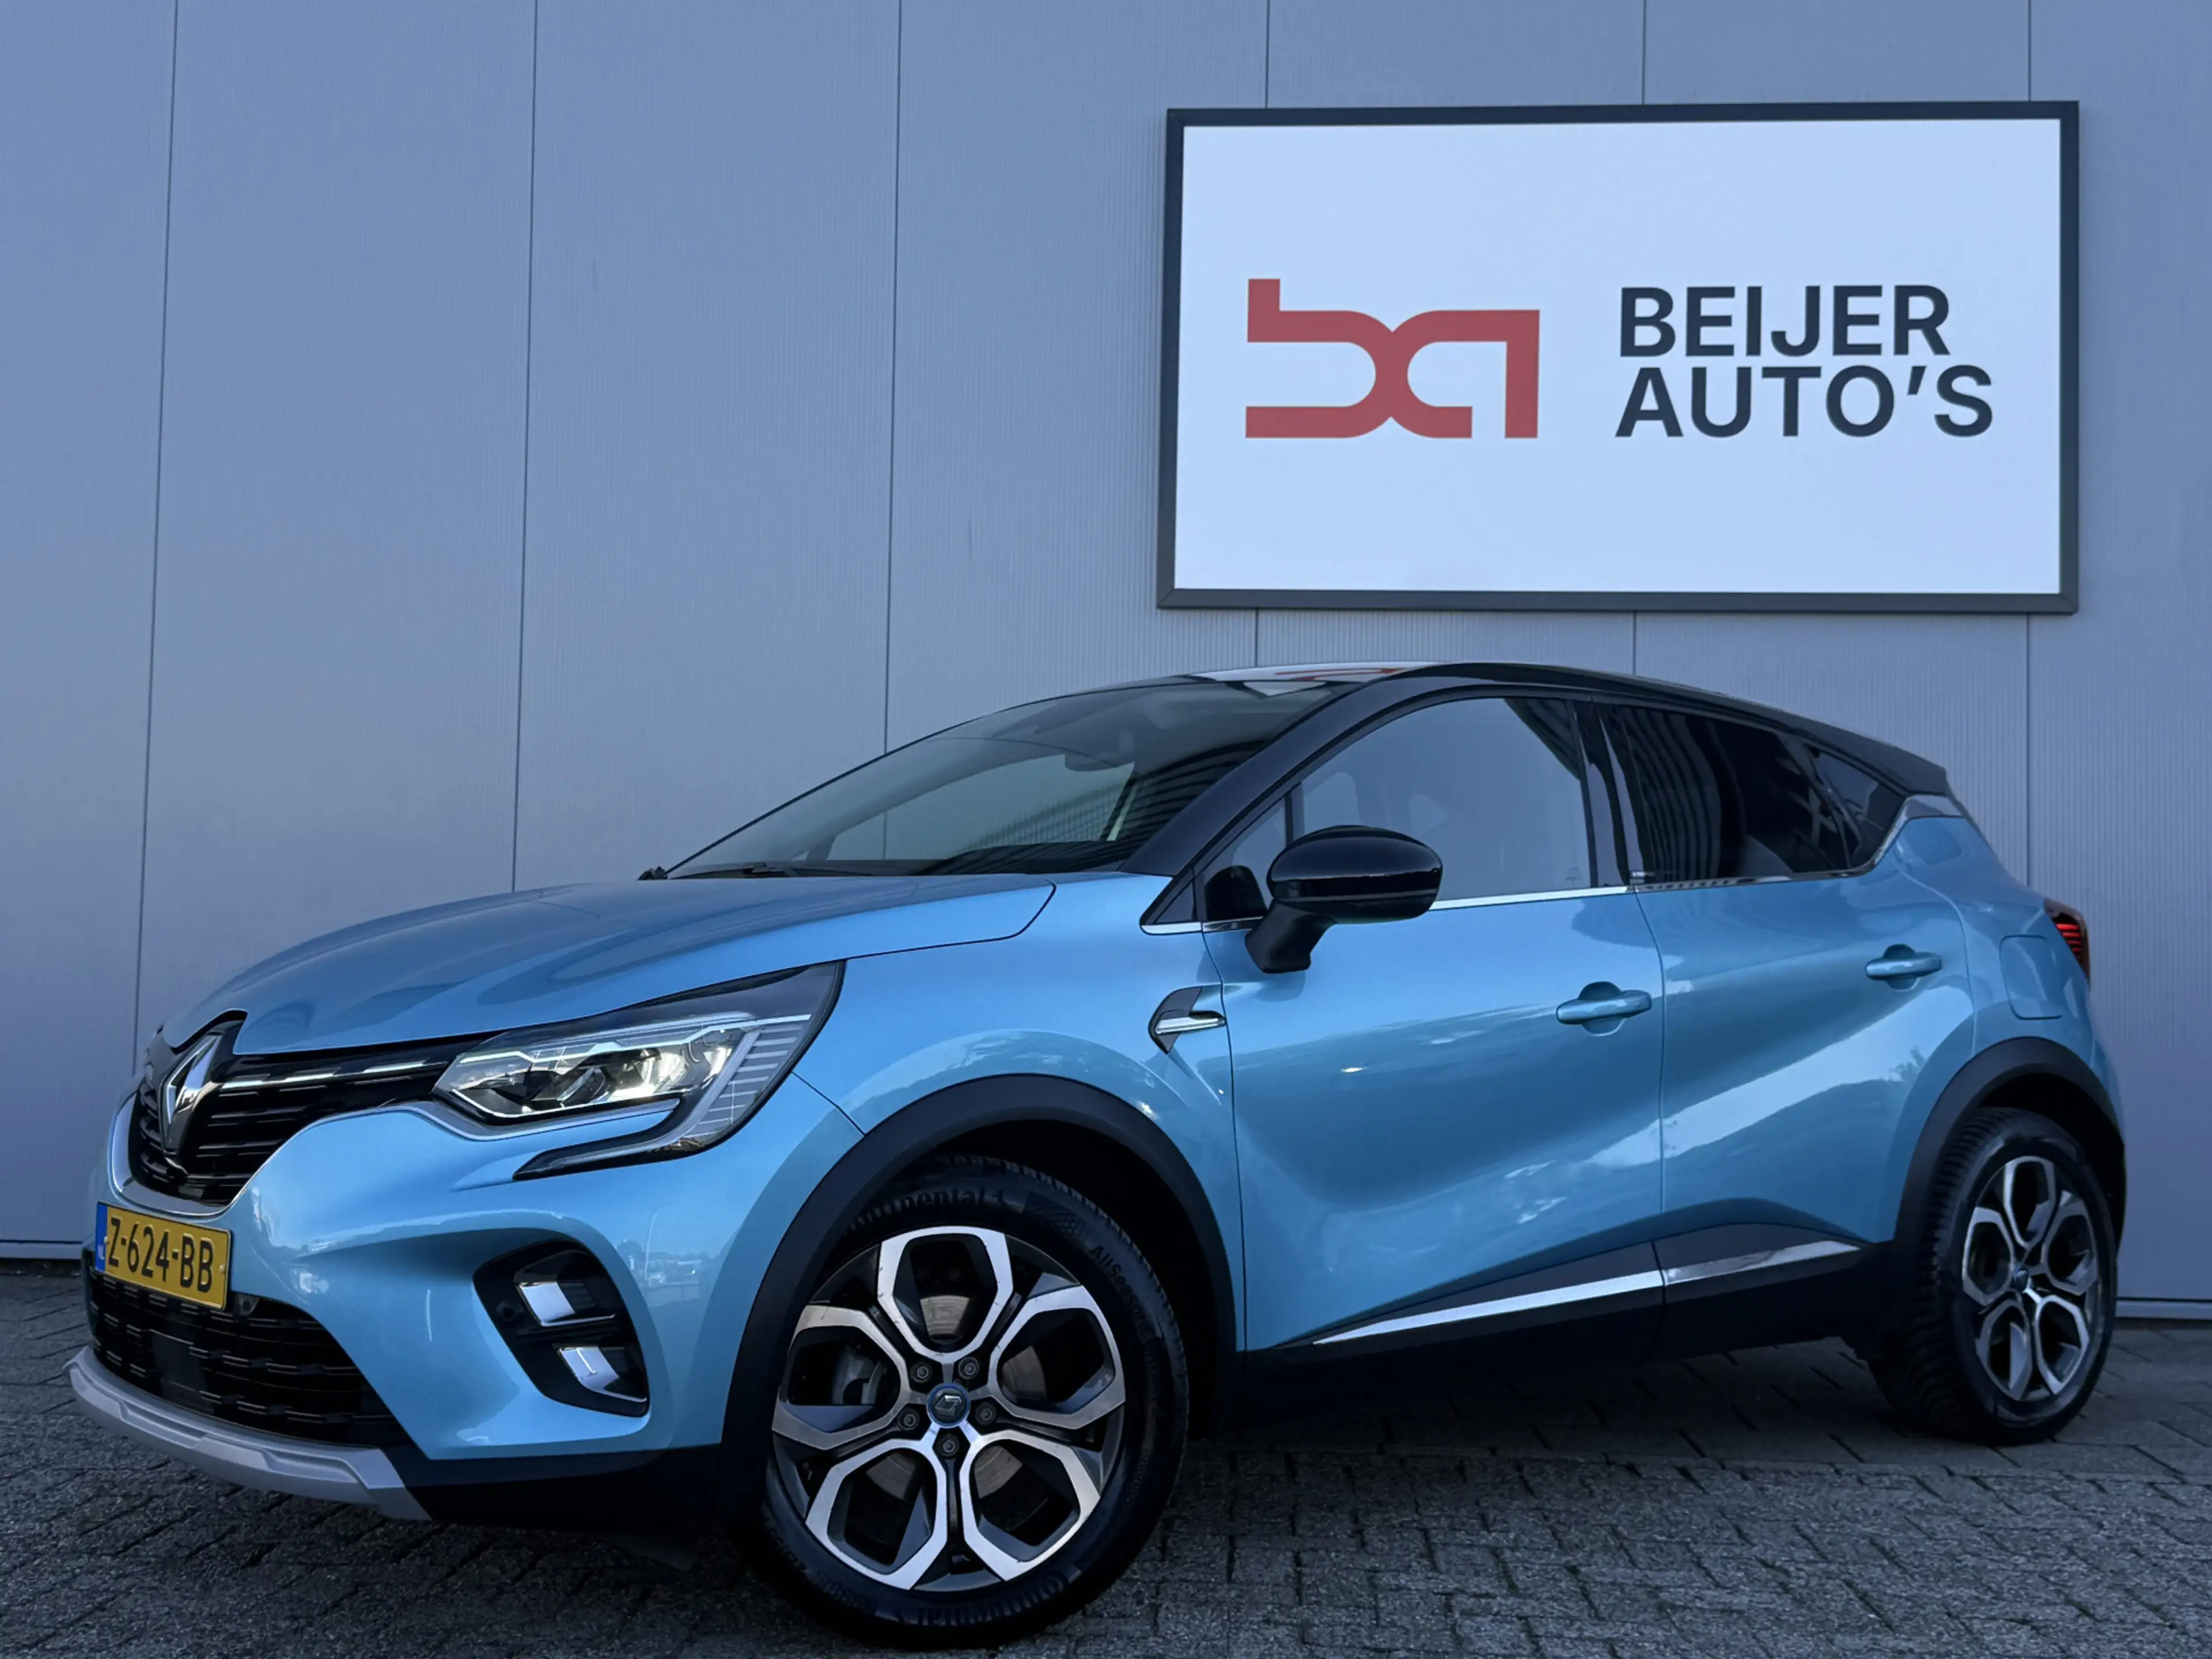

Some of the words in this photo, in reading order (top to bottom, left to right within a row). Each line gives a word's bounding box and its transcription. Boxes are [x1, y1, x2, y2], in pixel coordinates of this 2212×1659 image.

[1620, 285, 1950, 357] BEIJER
[1615, 365, 1993, 438] AUTO'S
[843, 1185, 986, 1236] nental
[108, 1215, 214, 1293] Z-624-BB
